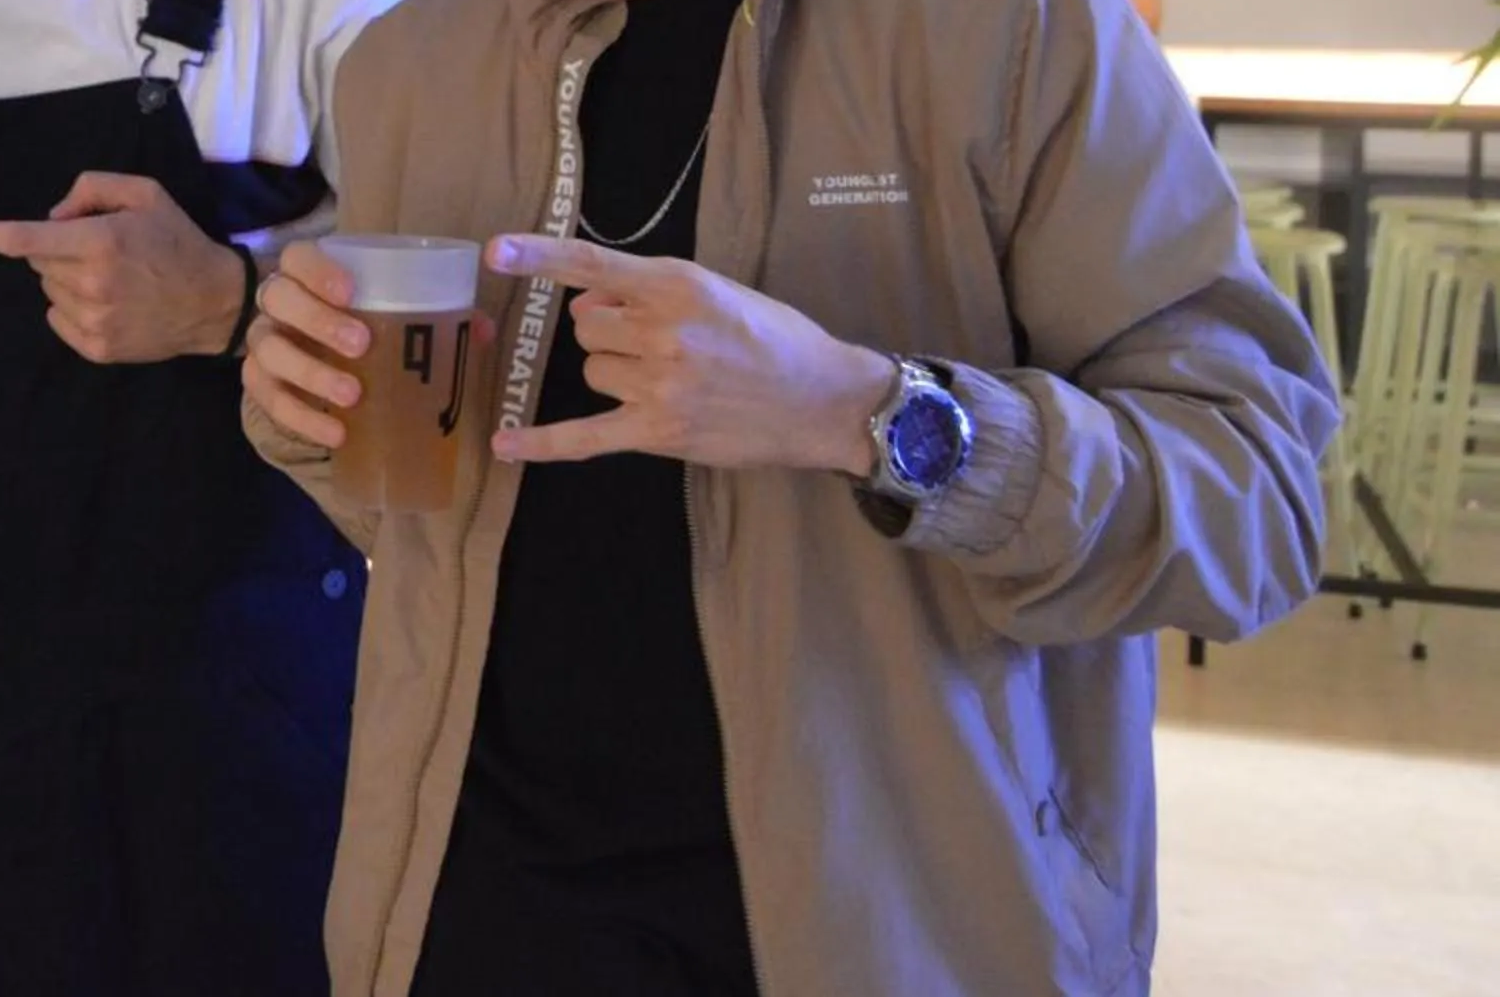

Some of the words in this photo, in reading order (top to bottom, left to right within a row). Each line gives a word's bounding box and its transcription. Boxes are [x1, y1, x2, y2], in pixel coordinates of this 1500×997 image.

[546, 59, 583, 244] YOUNGEST
[808, 190, 908, 206] GENERATION
[496, 277, 554, 443] ENERATIO
